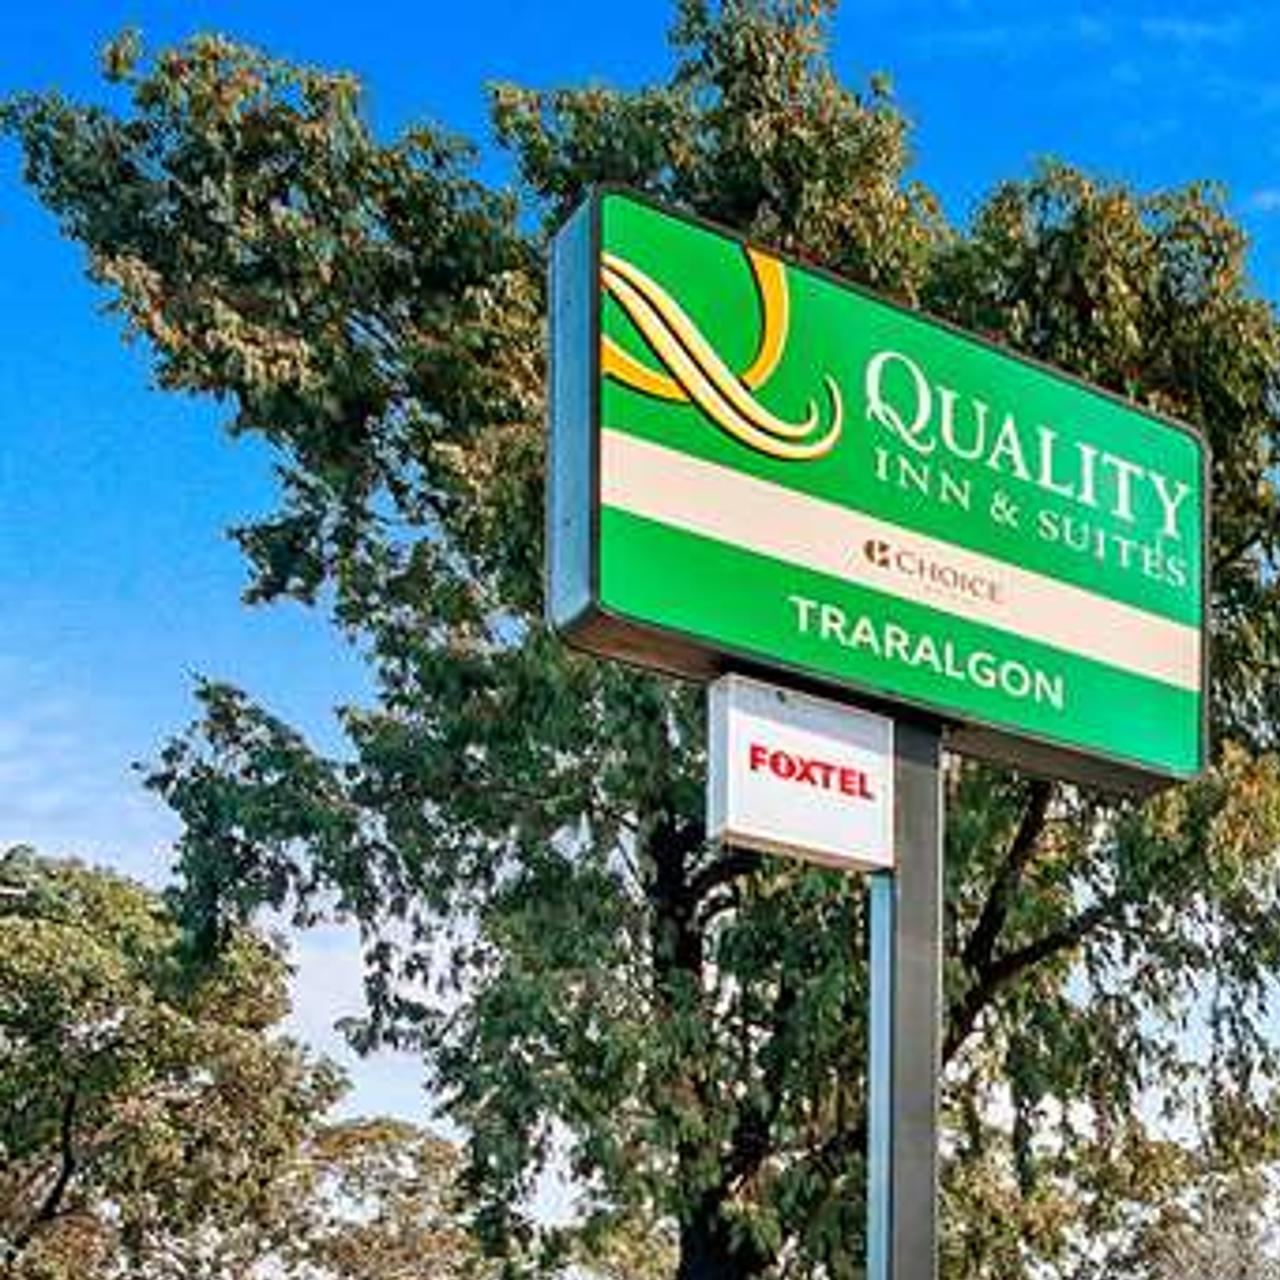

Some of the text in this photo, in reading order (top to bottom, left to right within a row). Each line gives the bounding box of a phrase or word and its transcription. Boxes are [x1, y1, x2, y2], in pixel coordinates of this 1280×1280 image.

[866, 352, 1190, 540] QUALITY
[875, 446, 1187, 587] INN & SUITES
[788, 596, 1065, 709] TRARALGON
[749, 743, 876, 801] FOXTEL
